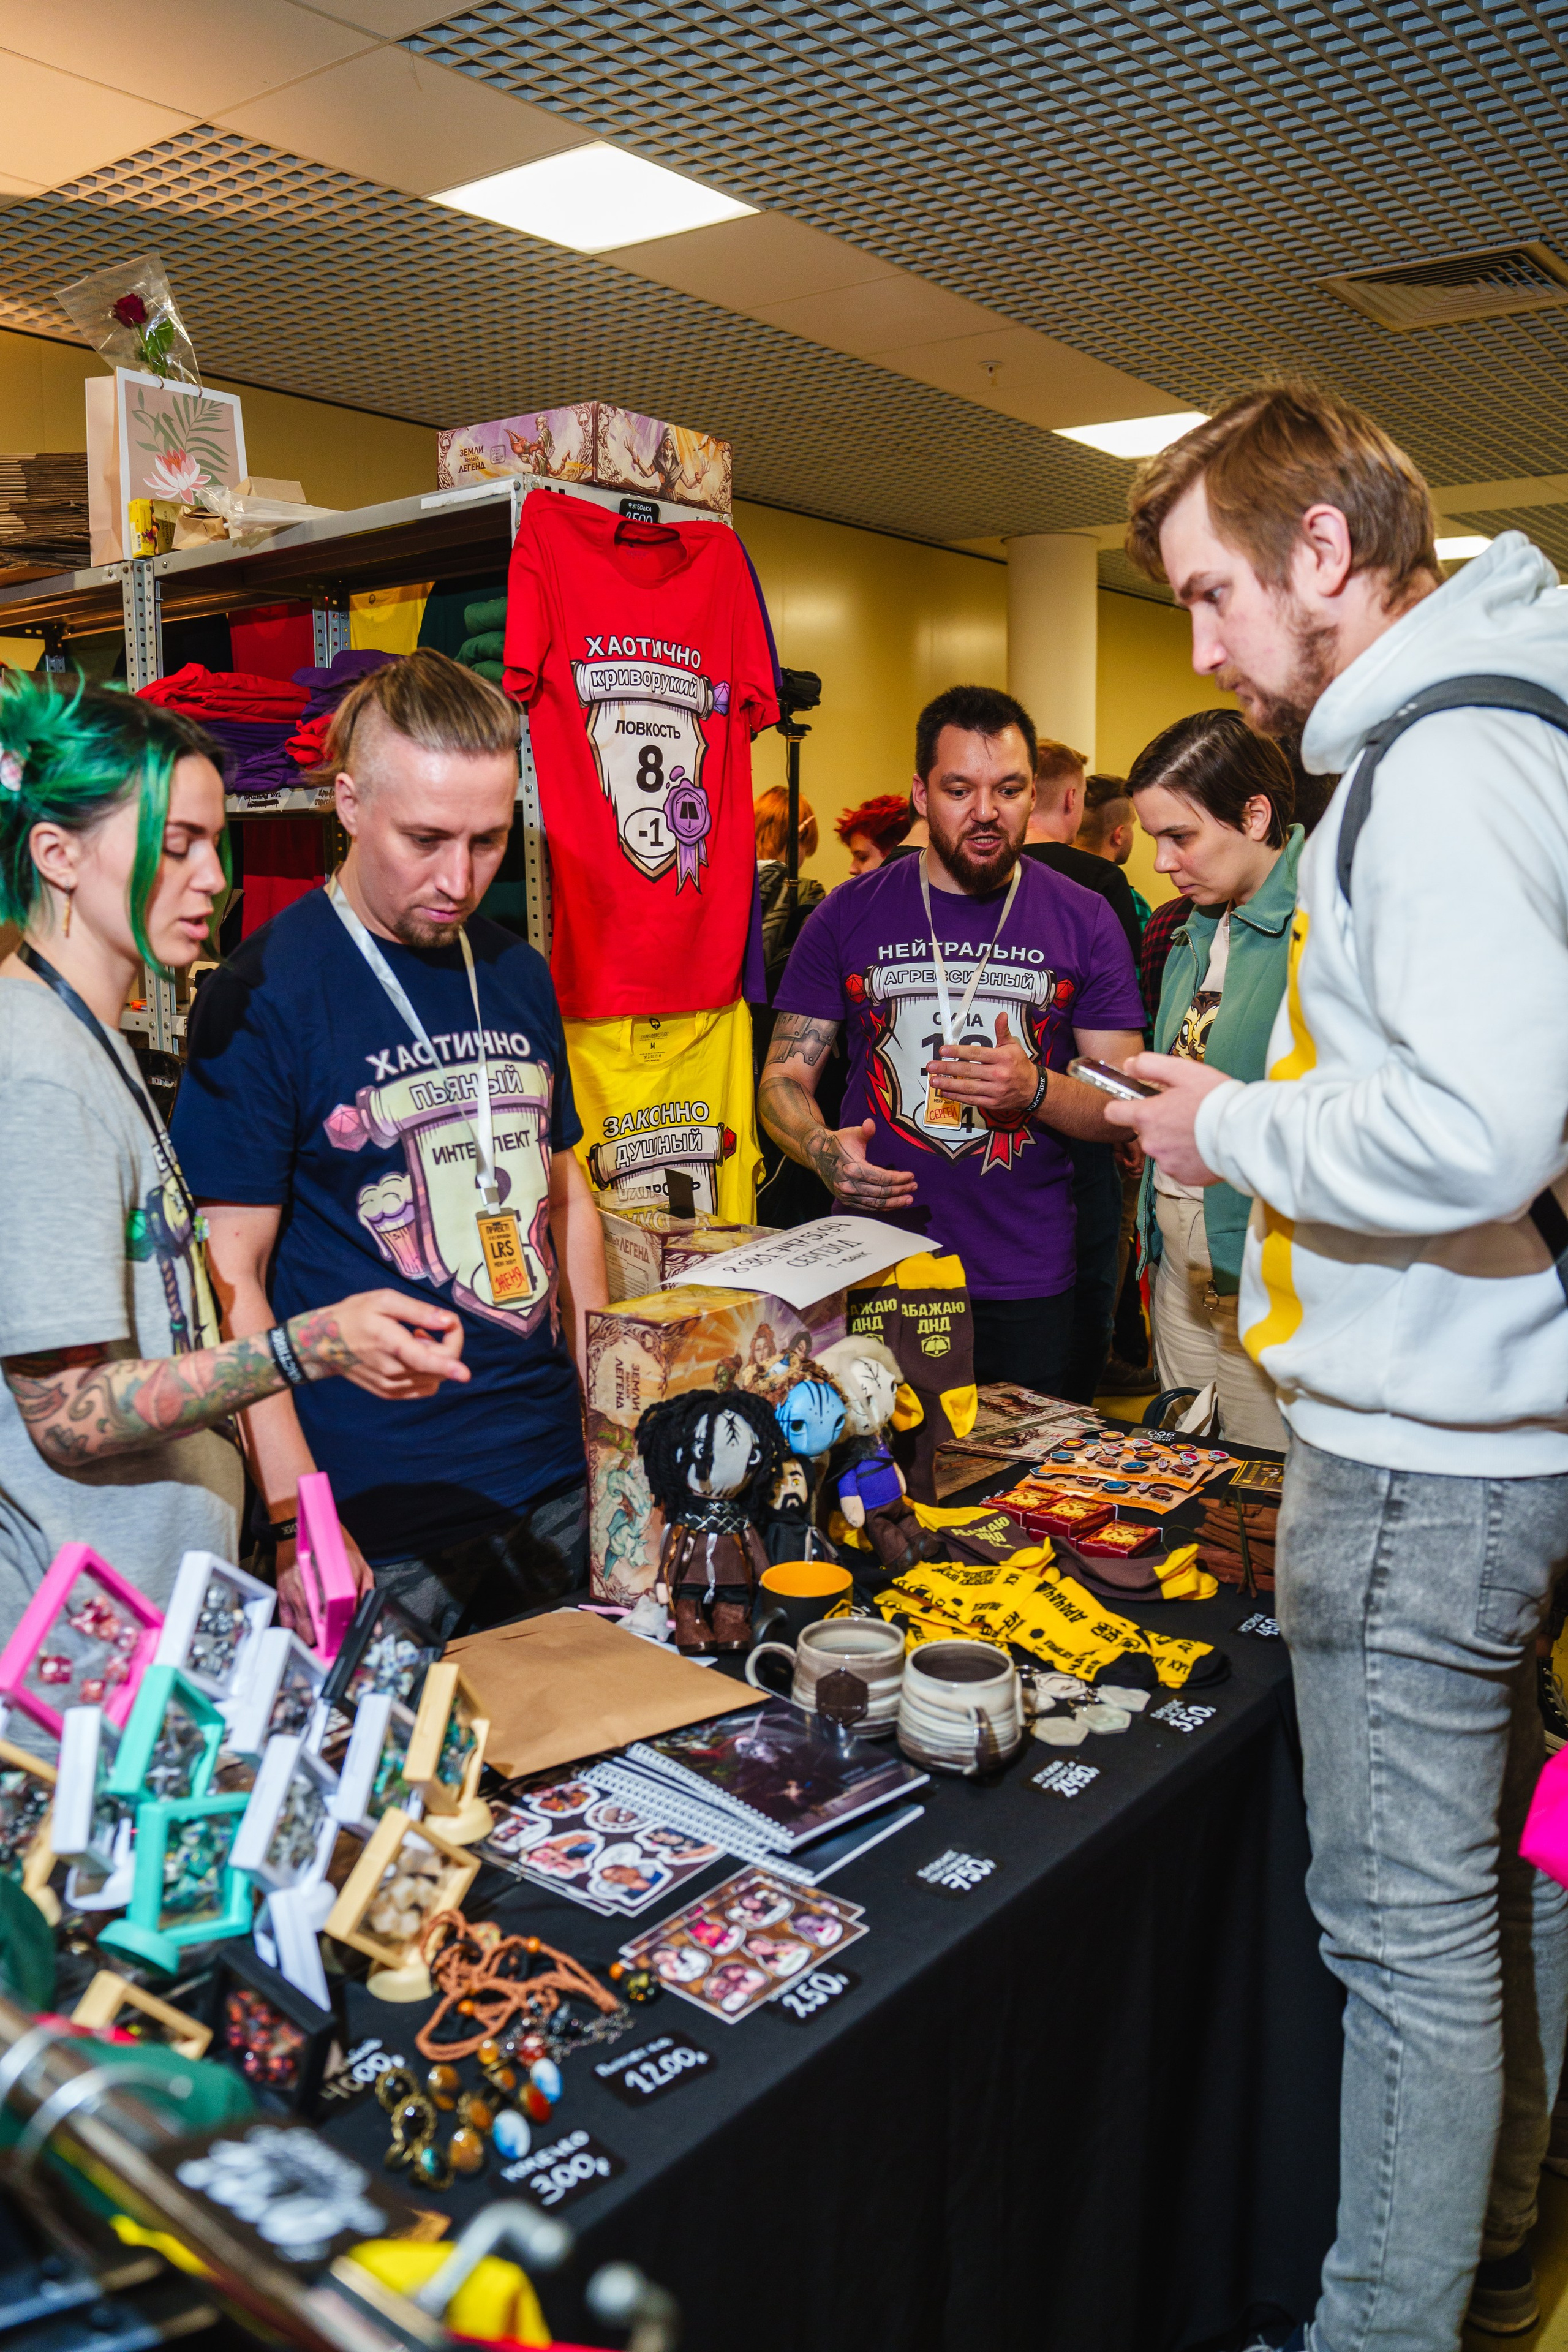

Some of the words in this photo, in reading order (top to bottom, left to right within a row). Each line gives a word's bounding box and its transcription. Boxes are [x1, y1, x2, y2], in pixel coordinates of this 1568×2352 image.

[460, 445, 484, 457] ЗЕМЛИ
[458, 461, 486, 473] ЛЕГЕНД
[628, 502, 652, 512] ФУТБОЛКА
[585, 635, 701, 669] ХАОТИЧНО
[591, 668, 698, 699] криворукий
[615, 720, 681, 740] ЛОВКОСТЬ
[636, 744, 665, 793] 8
[638, 817, 665, 847] -1
[878, 938, 1045, 964] НЕЙТРАЛЬНО
[366, 1030, 531, 1081] ХАОТИЧНО
[409, 1065, 524, 1110] ПЬЯНЫЙ
[1027, 1077, 1046, 1111] УЧАСТНИК
[603, 1101, 710, 1137] ЗАКОННО
[929, 1105, 957, 1121] СЕРГЕЙ
[432, 1130, 530, 1166] ИНТЕЛЕКТ
[615, 1129, 703, 1170] ДУШНЫЙ
[490, 1240, 514, 1259] LRS
[620, 1237, 650, 1264] ЛЕГЕНД
[787, 1243, 849, 1267] СЕРГЕЙ
[495, 1267, 526, 1294] ЖЕНЯ
[852, 1316, 884, 1333] ДНД
[916, 1317, 951, 1334] ДНД
[616, 1355, 624, 1409] ЛЕГЕНД
[631, 1363, 641, 1411] ЗЕМЛИ
